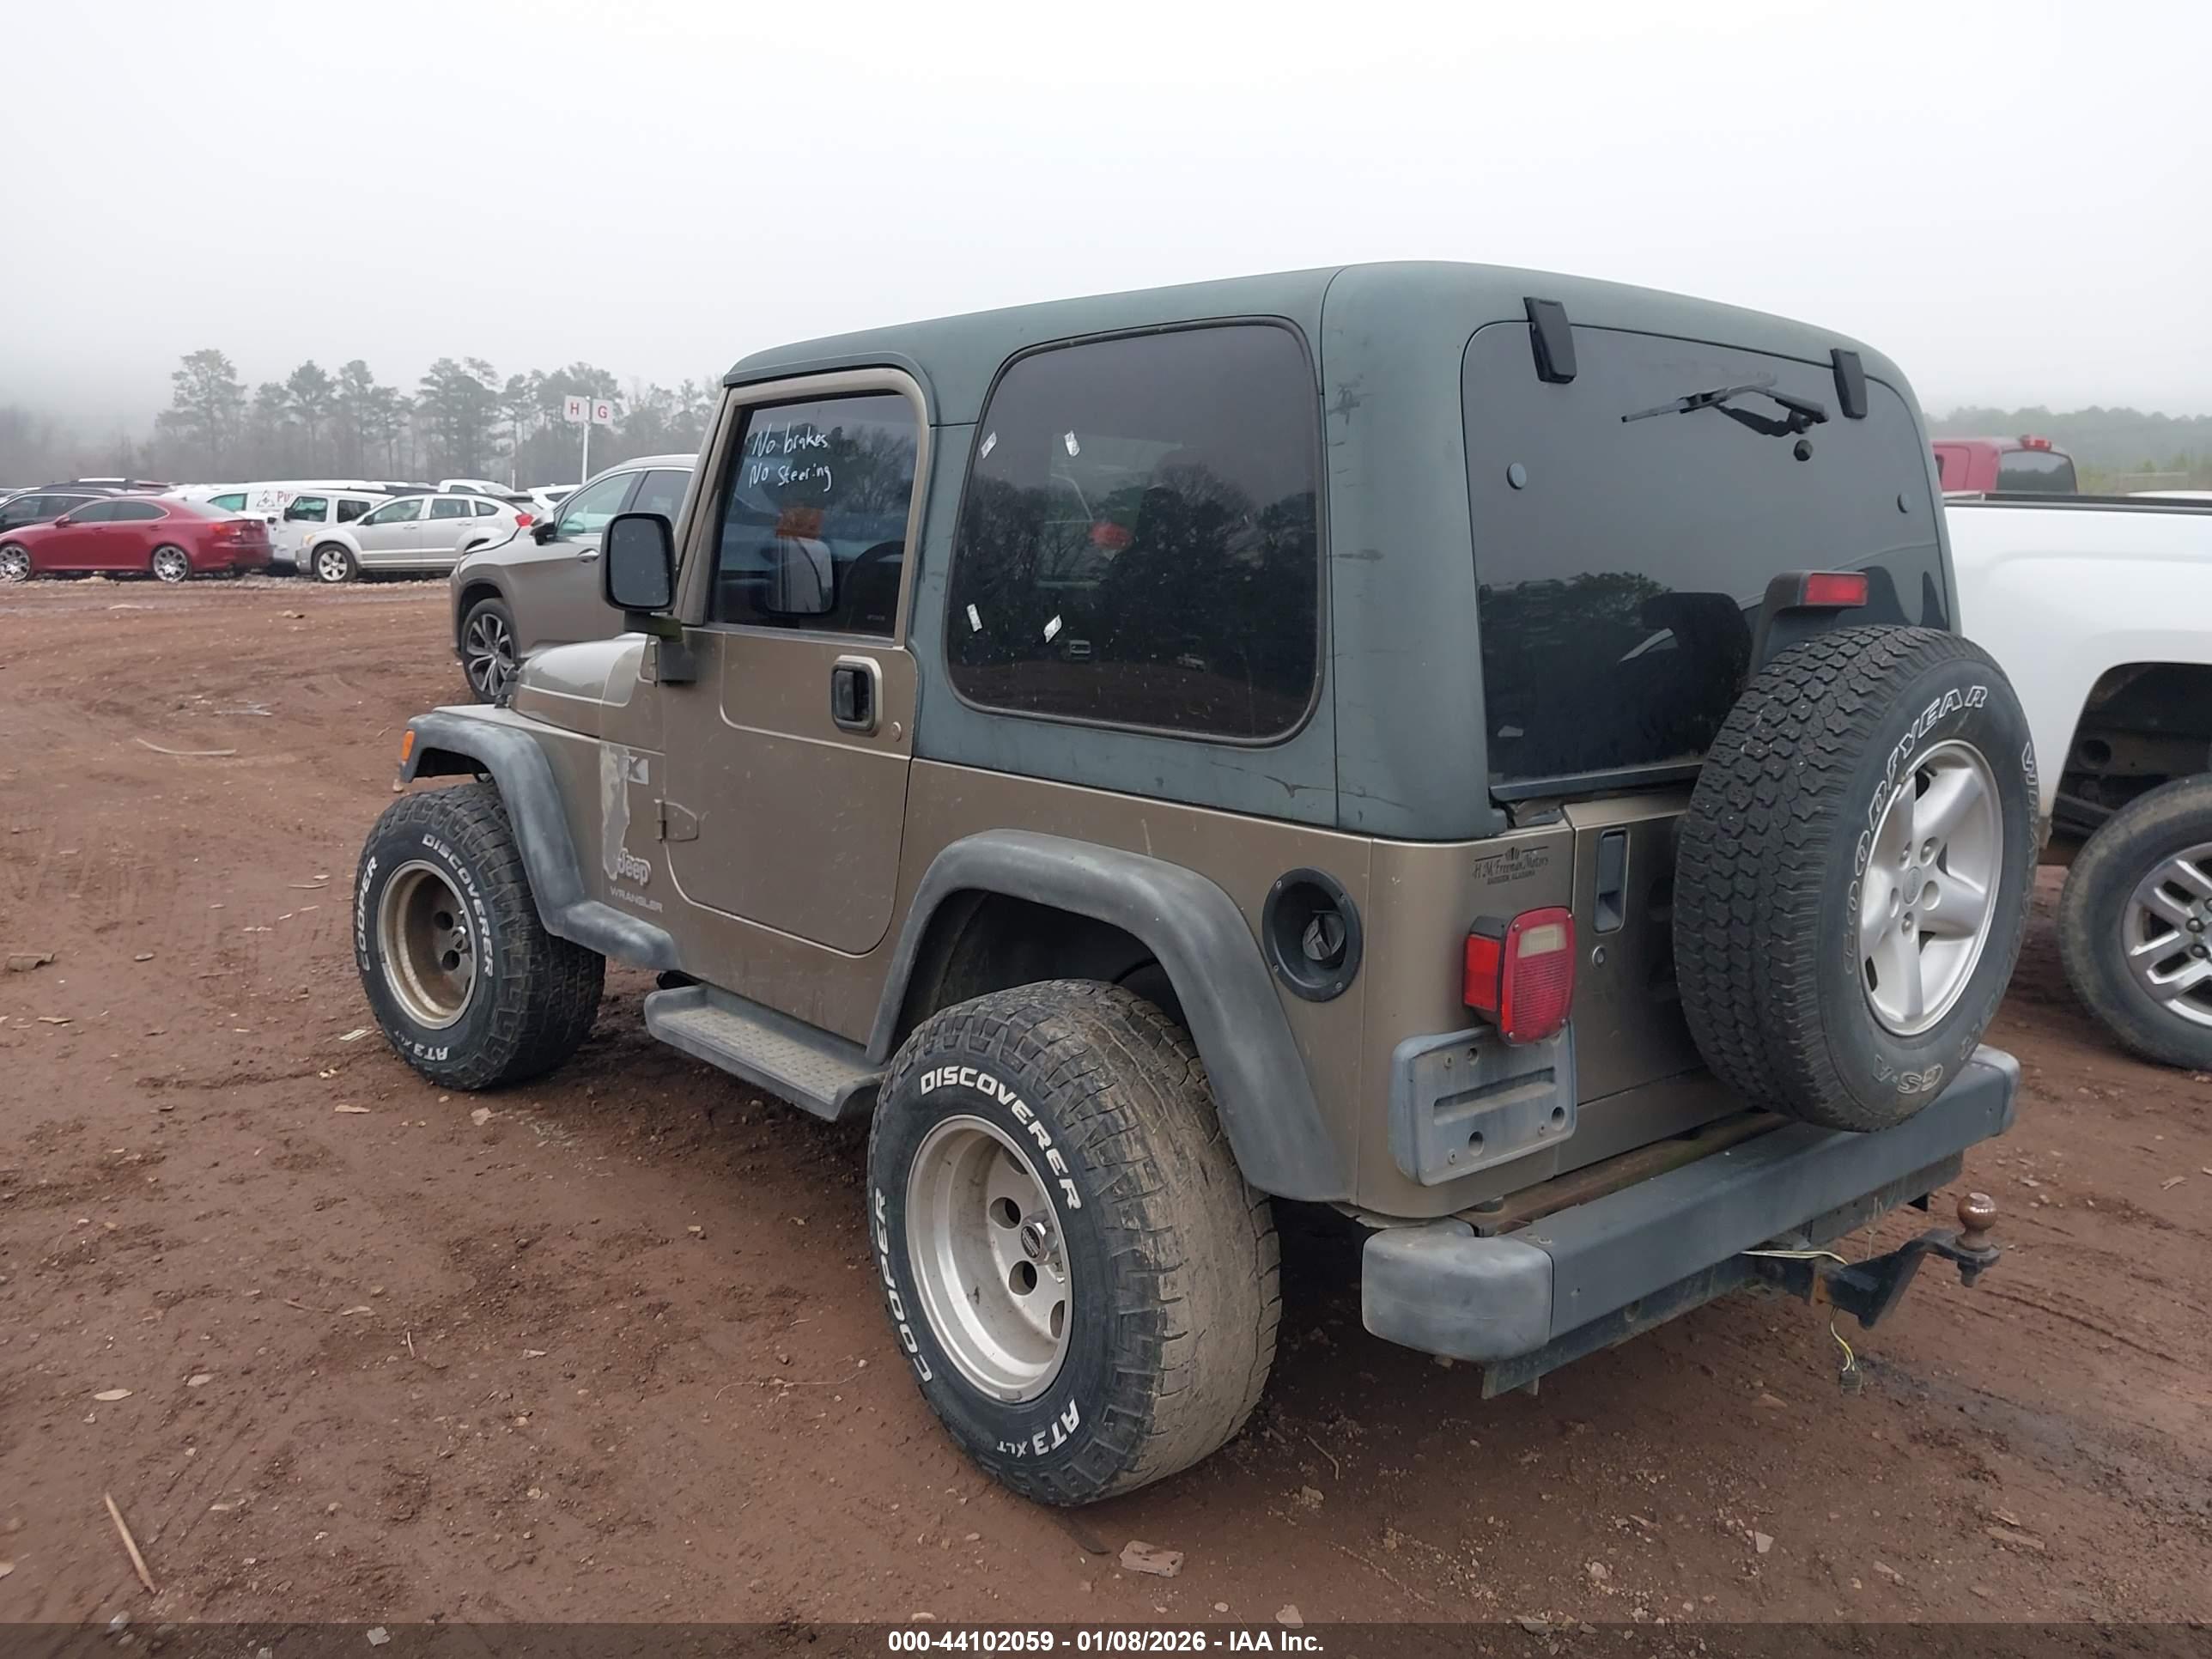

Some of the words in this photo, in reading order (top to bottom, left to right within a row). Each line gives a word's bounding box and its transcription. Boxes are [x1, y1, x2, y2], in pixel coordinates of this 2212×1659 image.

[570, 402, 580, 416] H
[598, 405, 608, 418] G
[751, 422, 775, 458] No
[783, 422, 829, 454] brakes
[749, 463, 769, 488] No
[1843, 684, 1989, 975] GOODYEAR
[617, 848, 652, 886] Jeep
[356, 856, 378, 971] COOPER
[421, 833, 495, 977] DISCOVERER
[413, 1042, 449, 1061] AT3
[920, 1064, 1084, 1211] DISCOVERER
[874, 1187, 933, 1384] COOPER
[1033, 1397, 1080, 1457] AT3
